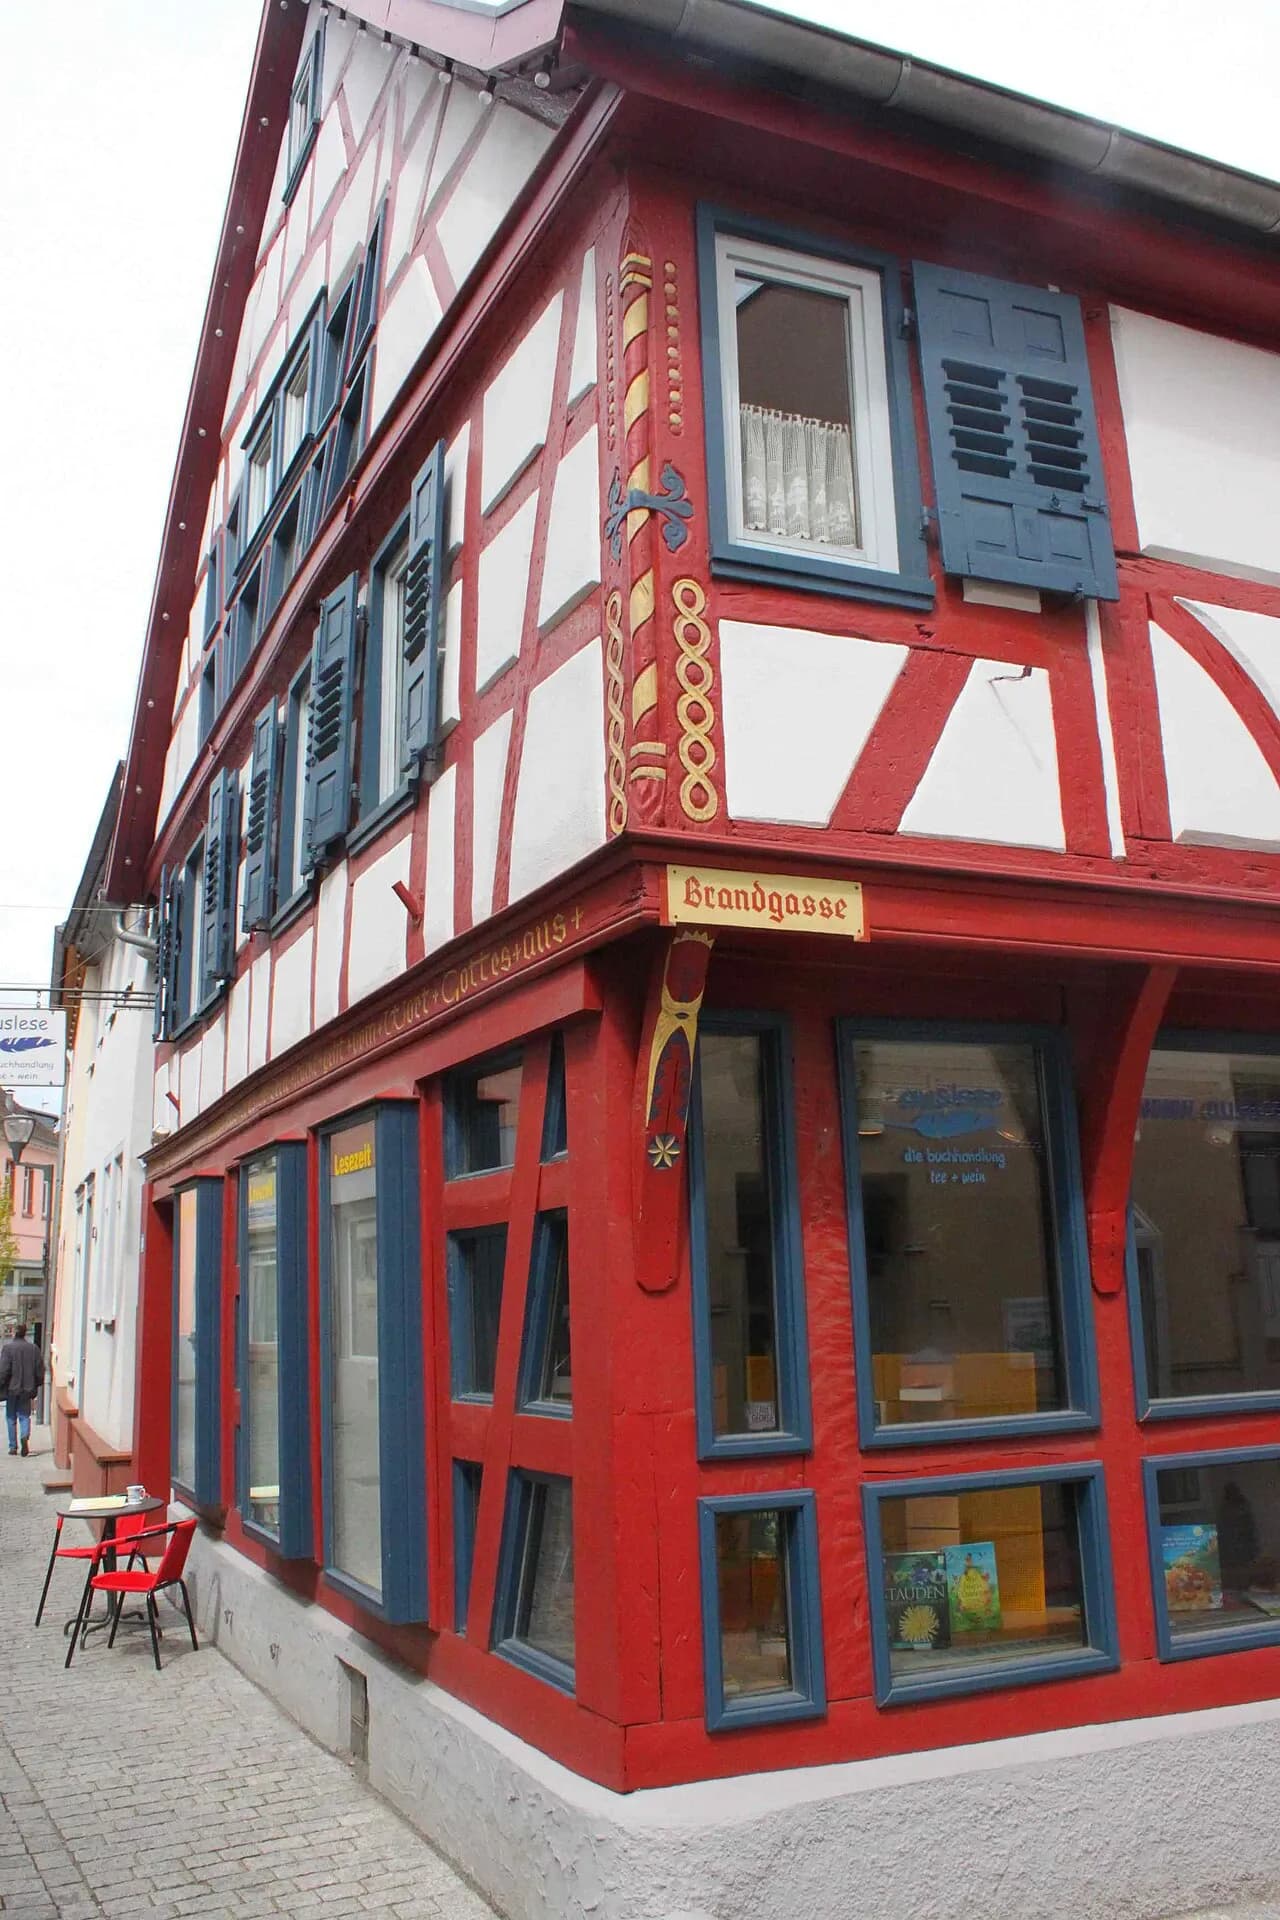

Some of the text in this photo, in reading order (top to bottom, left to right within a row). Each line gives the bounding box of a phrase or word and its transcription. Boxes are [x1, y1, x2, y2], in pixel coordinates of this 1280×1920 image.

[683, 875, 848, 923] Brandgasse
[523, 913, 567, 960] aus
[334, 1143, 371, 1175] Lesezeit
[904, 1147, 1006, 1168] die buchhandlung
[885, 1585, 945, 1601] TAUDEN
